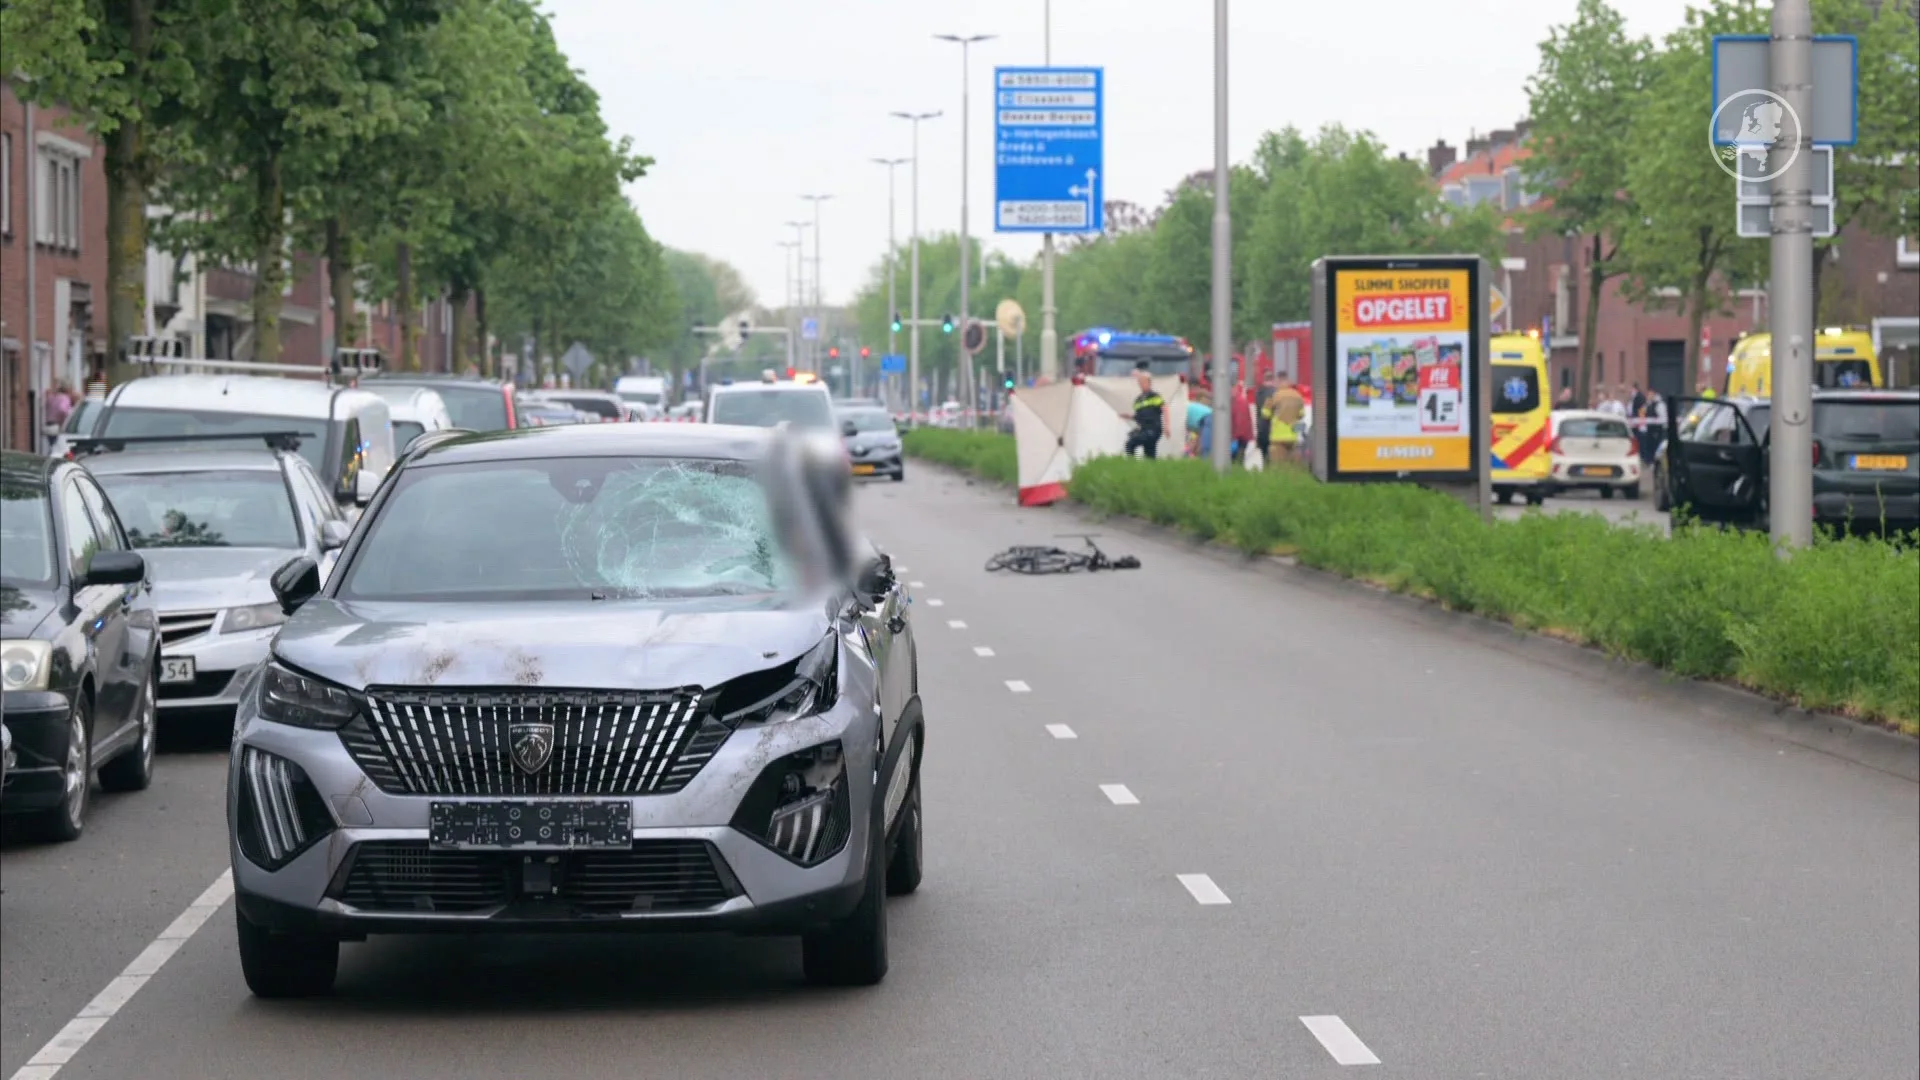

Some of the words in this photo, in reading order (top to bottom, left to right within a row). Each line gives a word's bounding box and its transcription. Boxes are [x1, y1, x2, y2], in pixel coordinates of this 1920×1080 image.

[1049, 112, 1092, 124] Bergen
[998, 141, 1034, 152] Breda
[998, 154, 1063, 165] Eindhoven
[1354, 278, 1393, 291] SLIMME
[1399, 277, 1450, 290] SHOPPER
[1357, 296, 1447, 323] OPGELET
[1376, 446, 1434, 459] JUMBO
